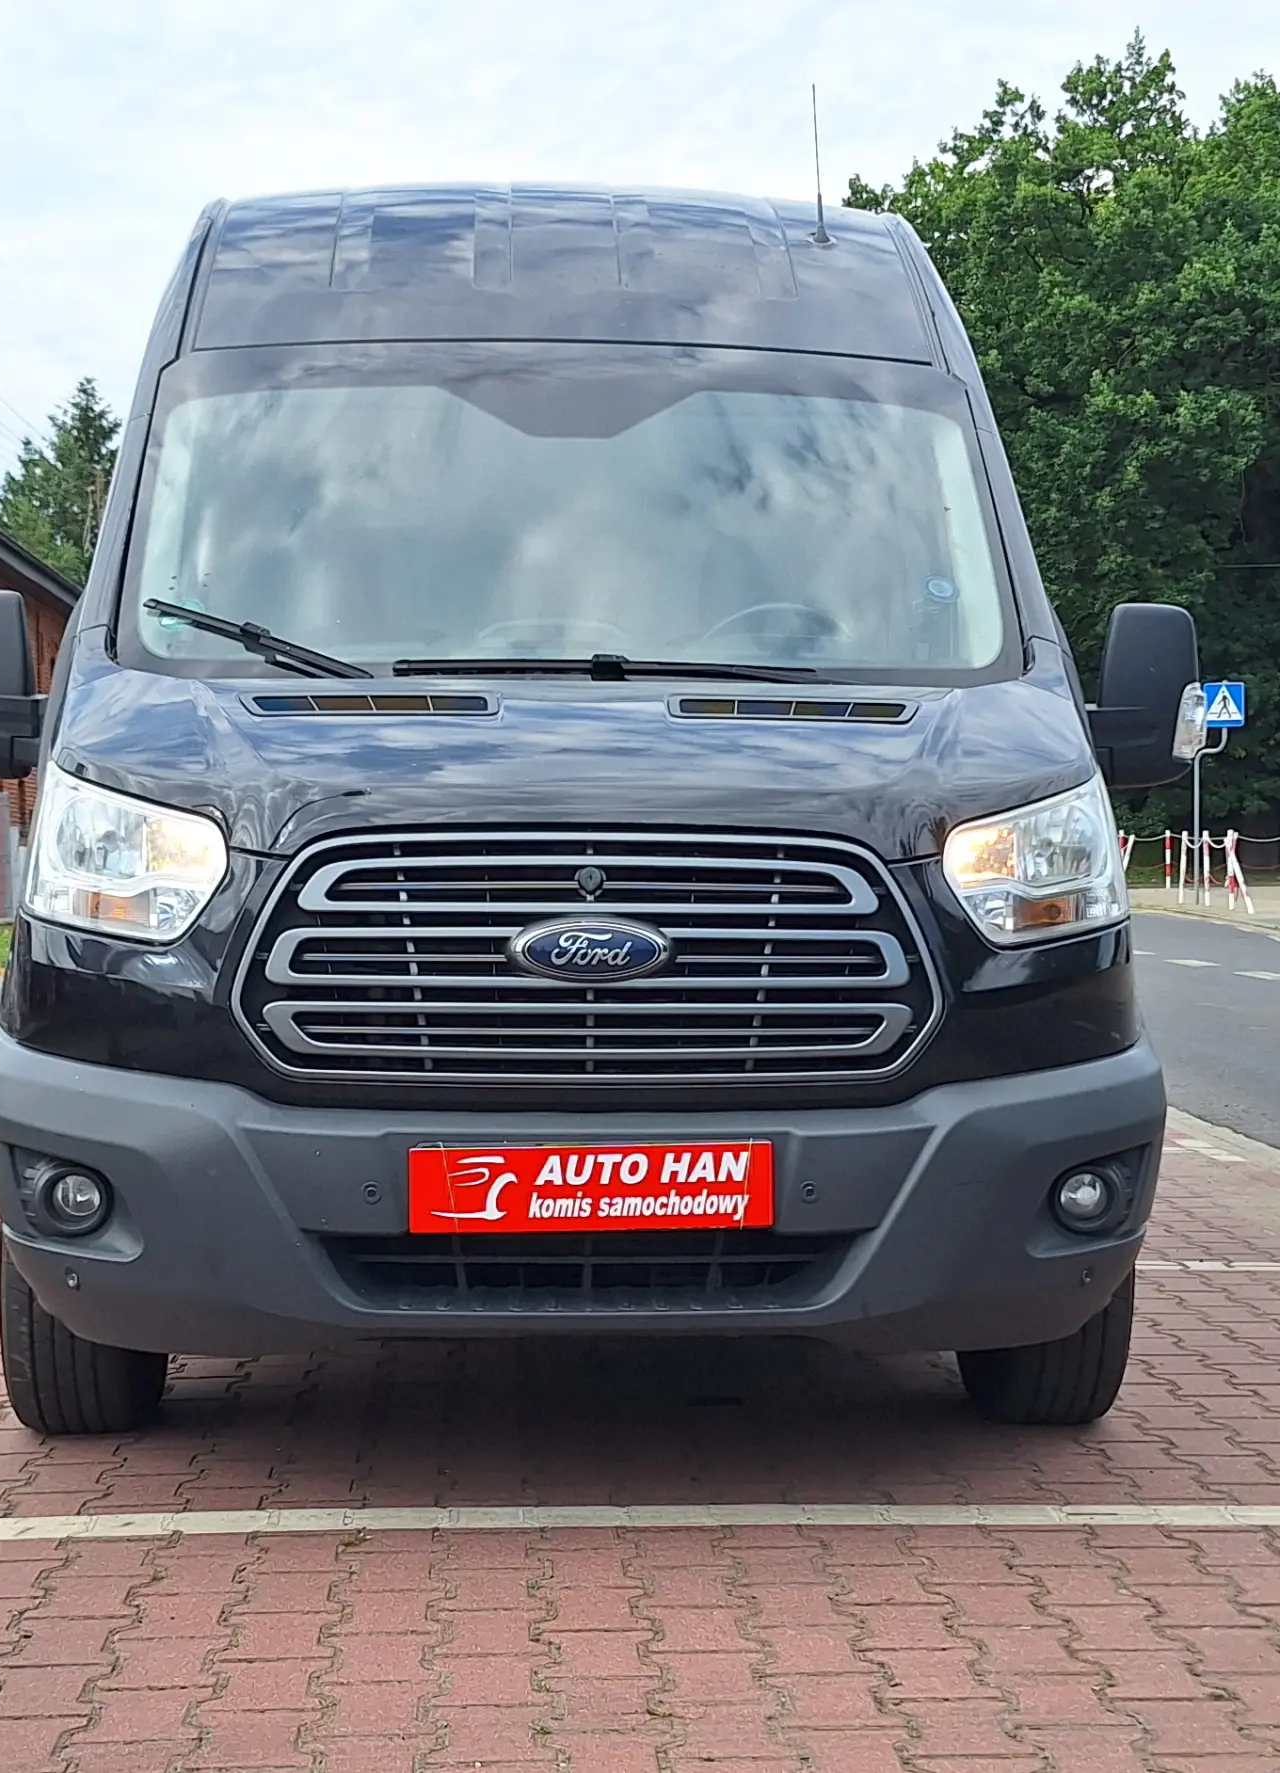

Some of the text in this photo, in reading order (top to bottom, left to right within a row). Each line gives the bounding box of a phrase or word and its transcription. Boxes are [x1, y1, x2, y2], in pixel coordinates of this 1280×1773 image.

[550, 931, 633, 966] Ford
[535, 1151, 749, 1186] AUTO HAN
[528, 1188, 750, 1221] komis samochodowy
